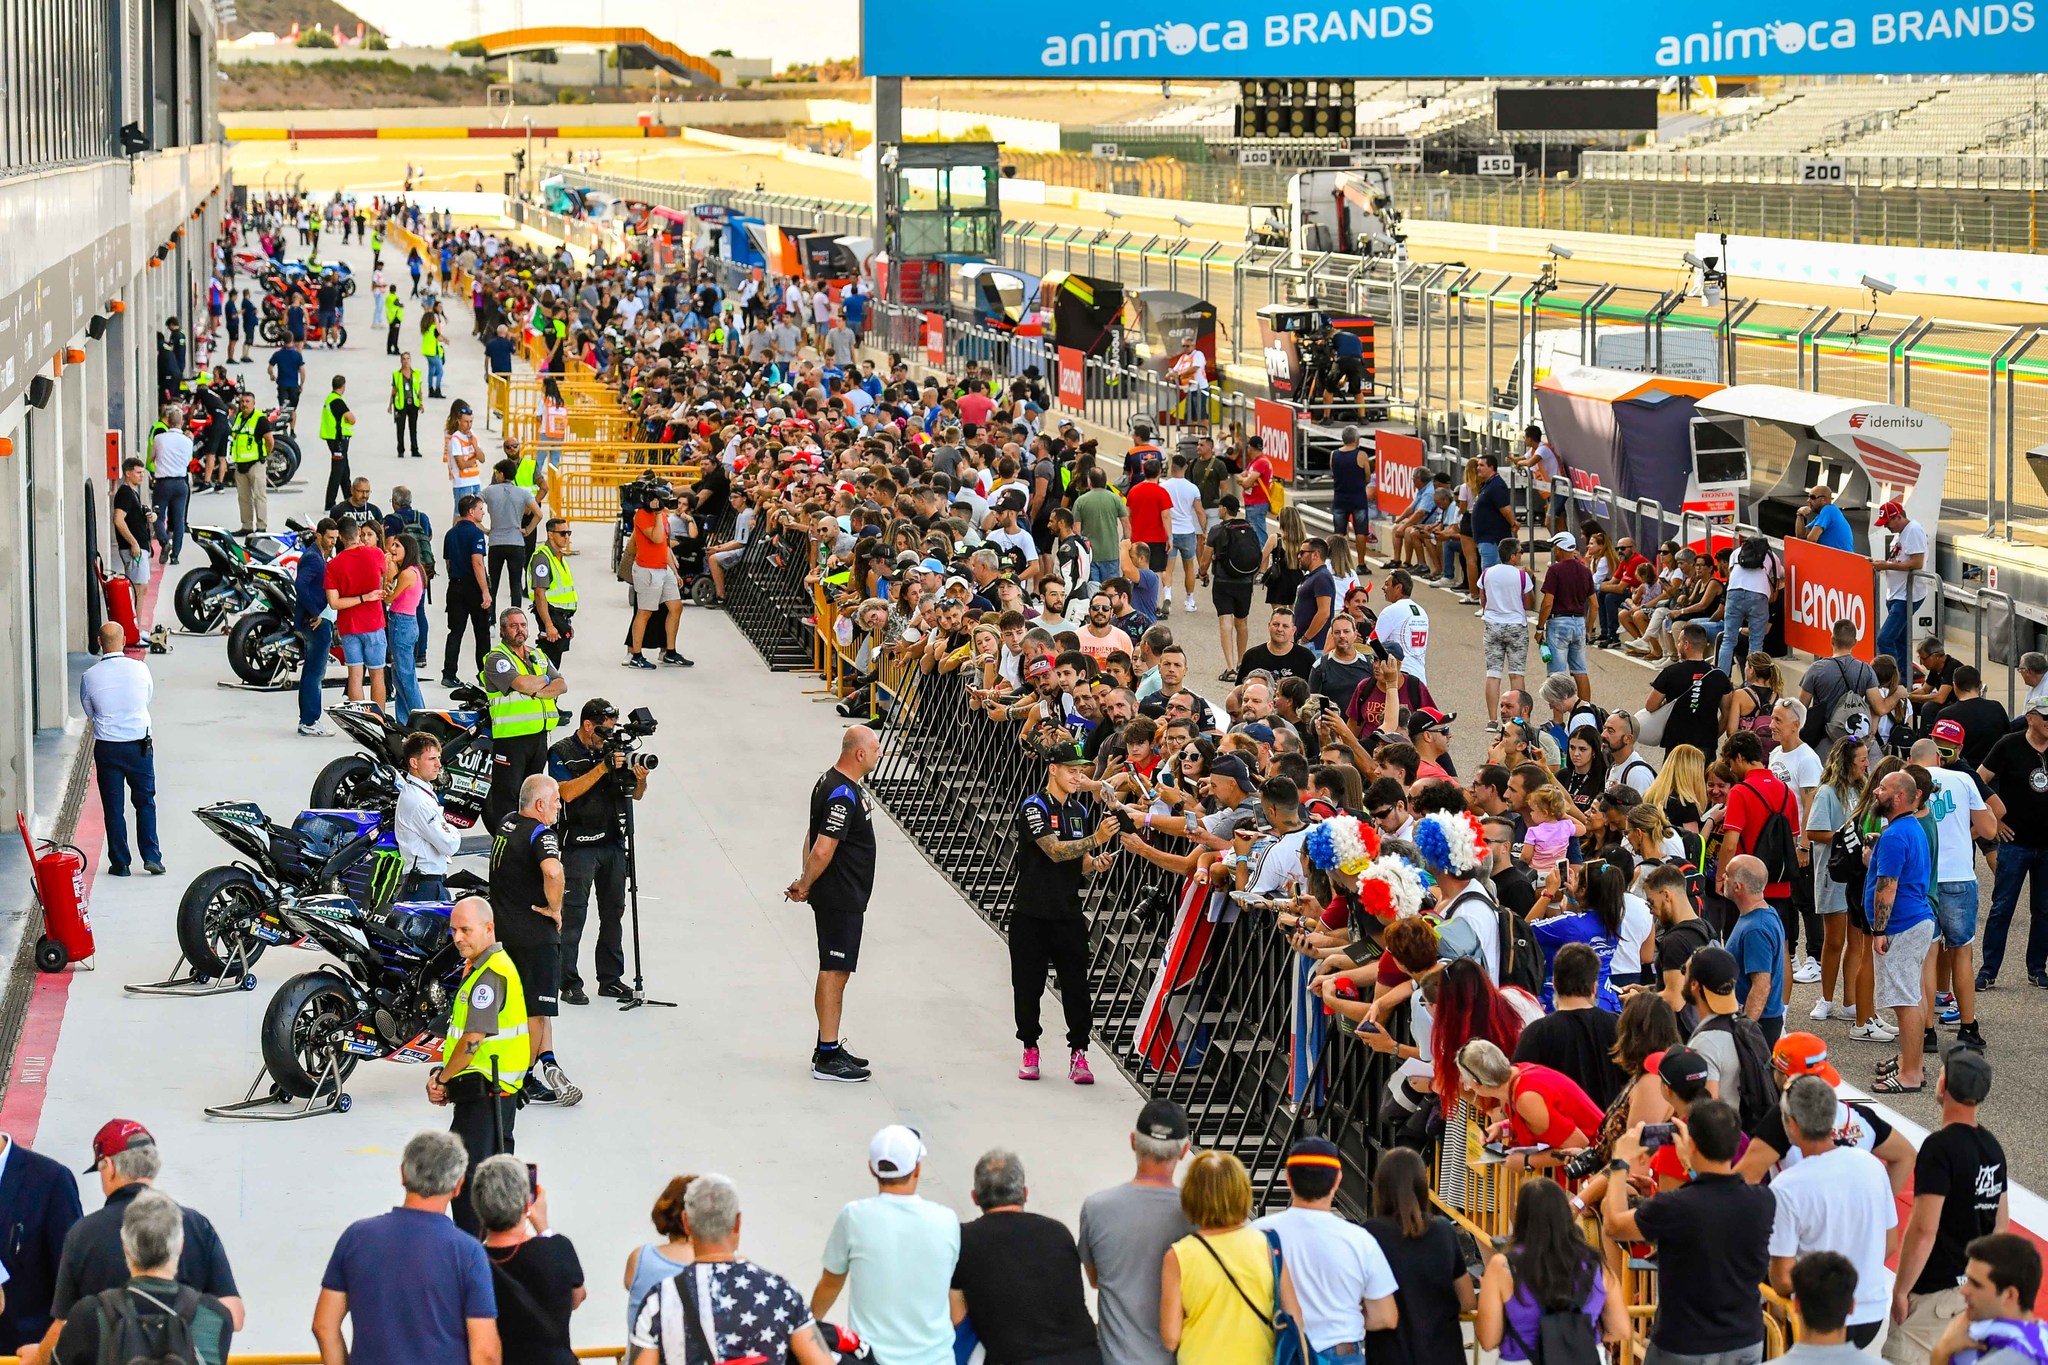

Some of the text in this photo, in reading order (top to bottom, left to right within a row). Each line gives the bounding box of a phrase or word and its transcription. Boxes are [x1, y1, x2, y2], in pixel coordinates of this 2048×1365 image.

[1041, 3, 1434, 67] animoca BRANDS
[1655, 2, 2036, 67] animoca BRANDS
[1102, 146, 1115, 154] 50
[1244, 153, 1267, 163] 100
[1482, 160, 1510, 170] 150
[1805, 166, 1840, 180] 200
[1168, 328, 1185, 338] elf
[1059, 361, 1082, 396] Lenovo
[1869, 416, 1924, 428] idemitsu
[1257, 415, 1290, 462] Lenovo
[1791, 565, 1866, 642] Lenovo
[1411, 631, 1427, 647] 20
[1937, 721, 1960, 733] HONDA
[404, 1049, 427, 1060] BLUE
